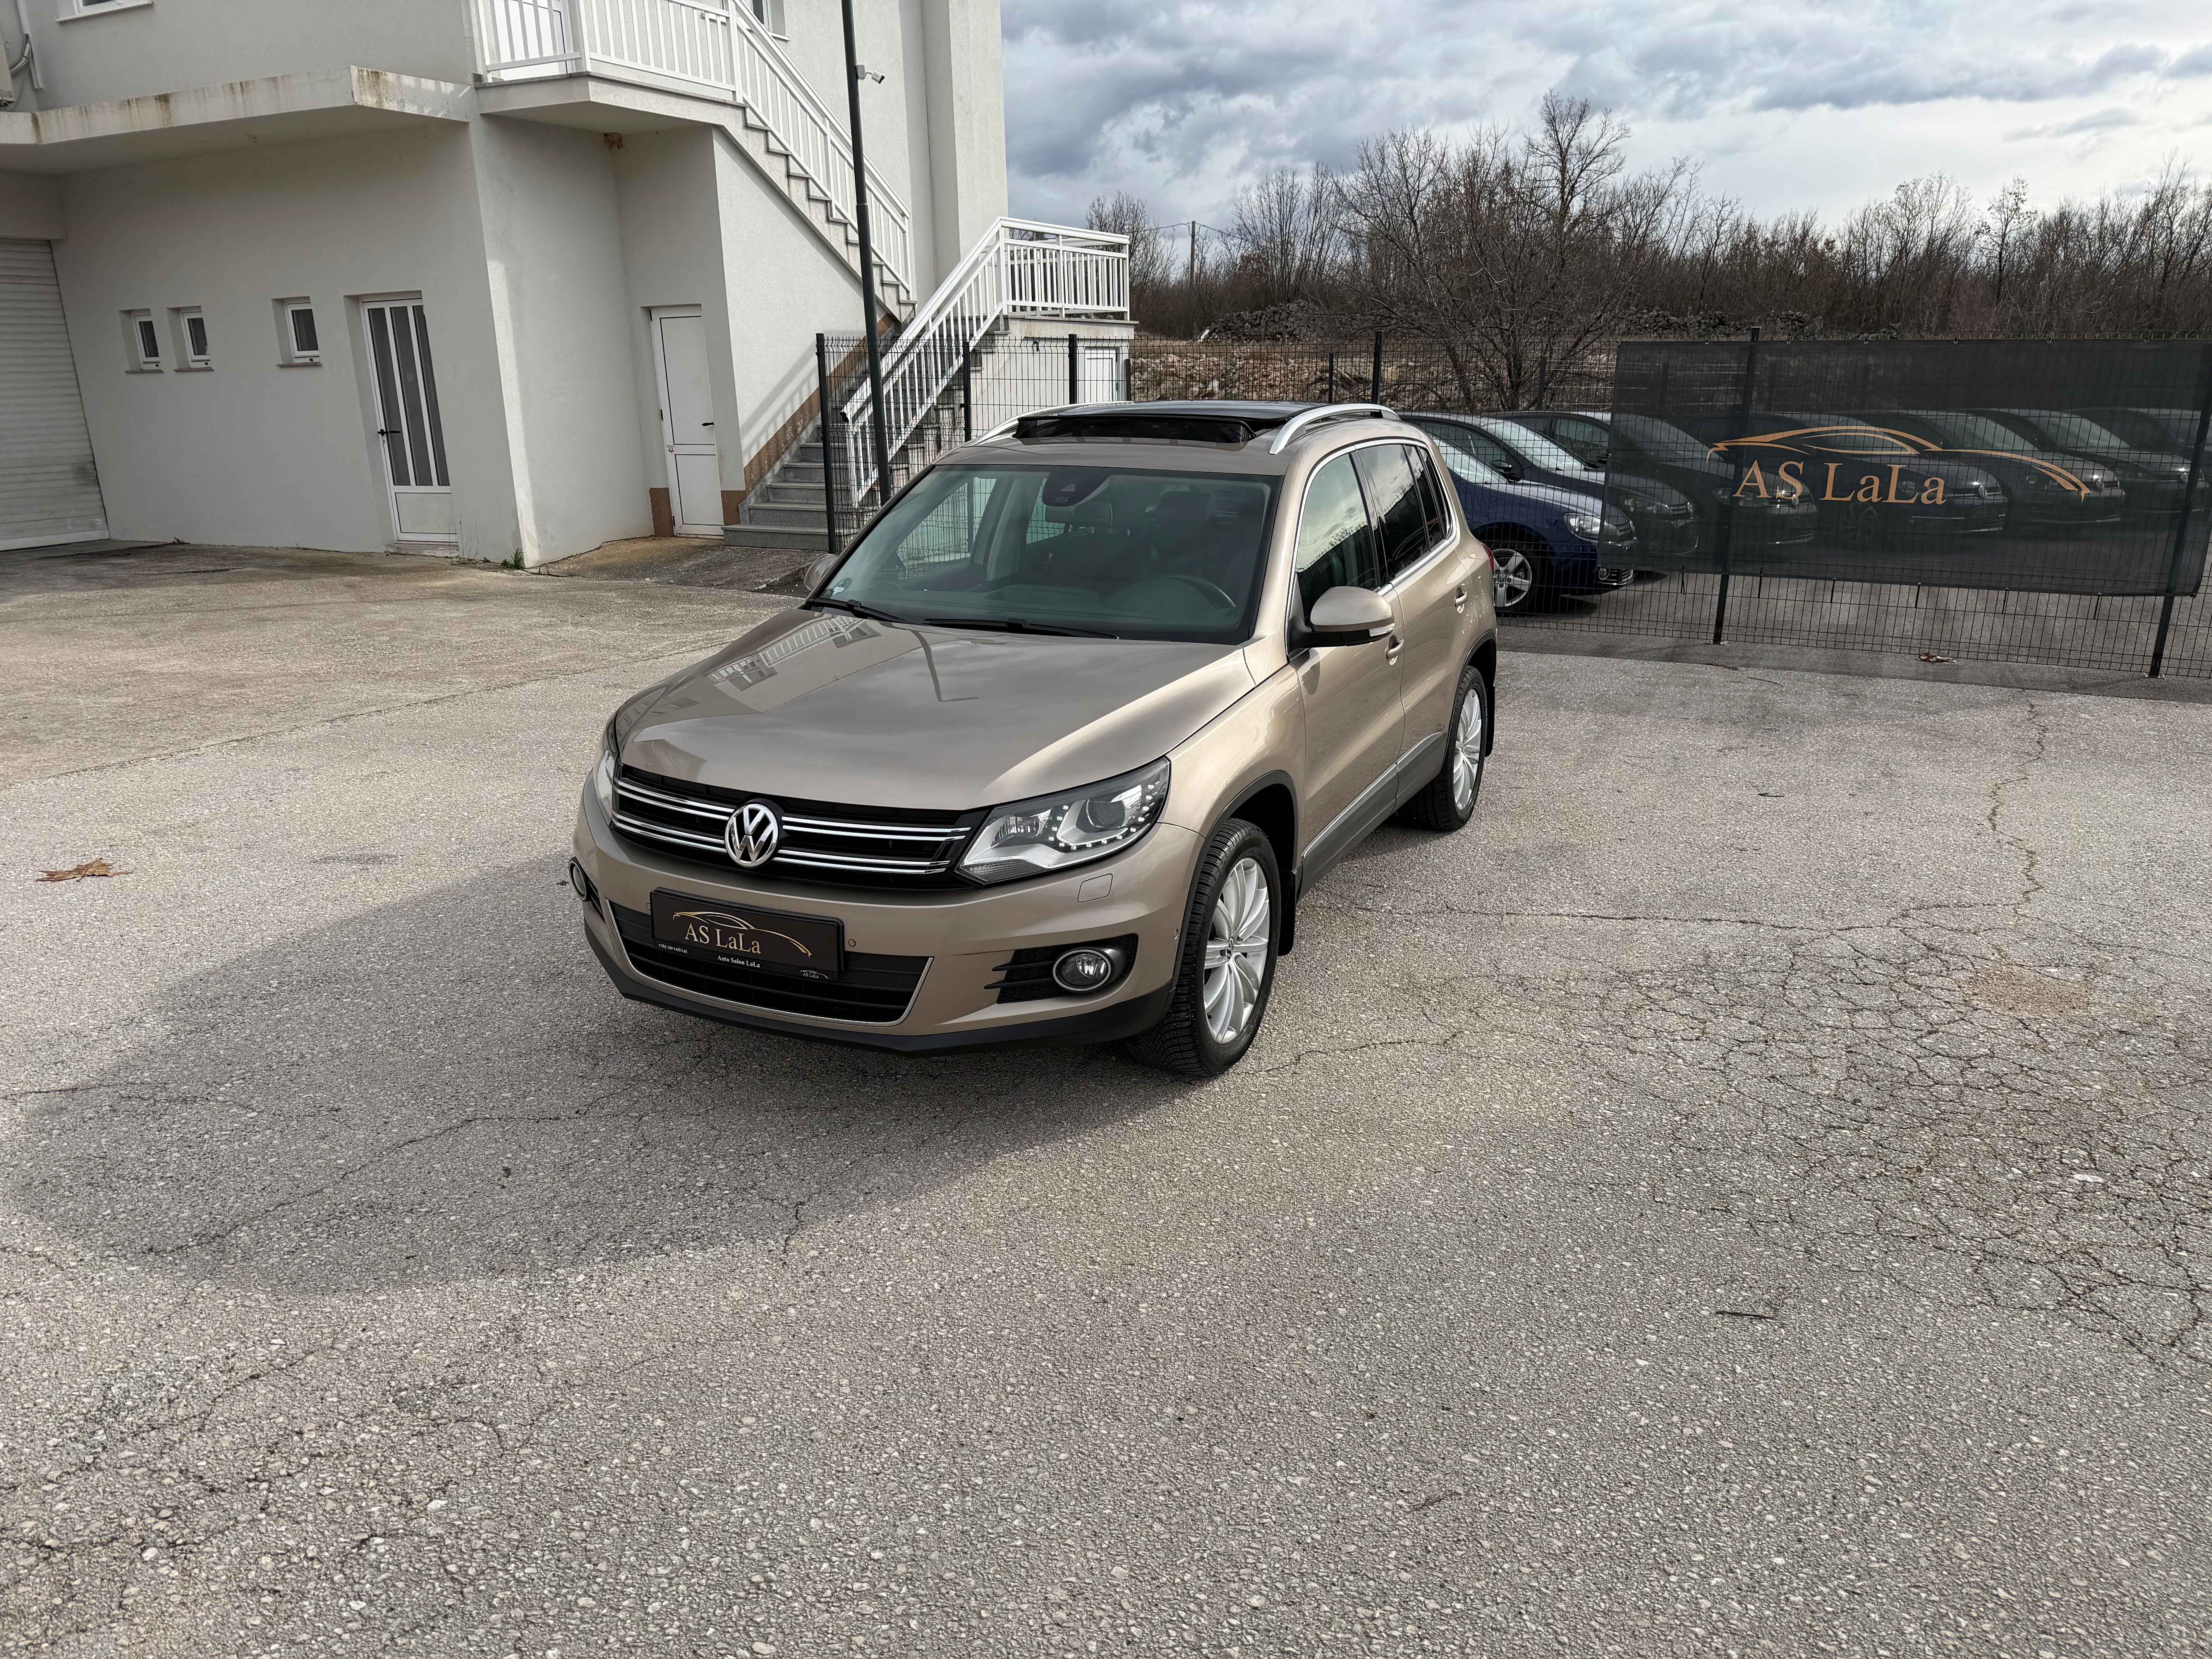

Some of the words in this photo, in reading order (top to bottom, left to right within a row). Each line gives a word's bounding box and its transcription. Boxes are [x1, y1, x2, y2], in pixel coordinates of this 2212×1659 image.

[1732, 460, 1803, 500] AS
[1820, 462, 1947, 505] LaLa
[684, 923, 710, 944] AS
[714, 928, 762, 954] LaLa
